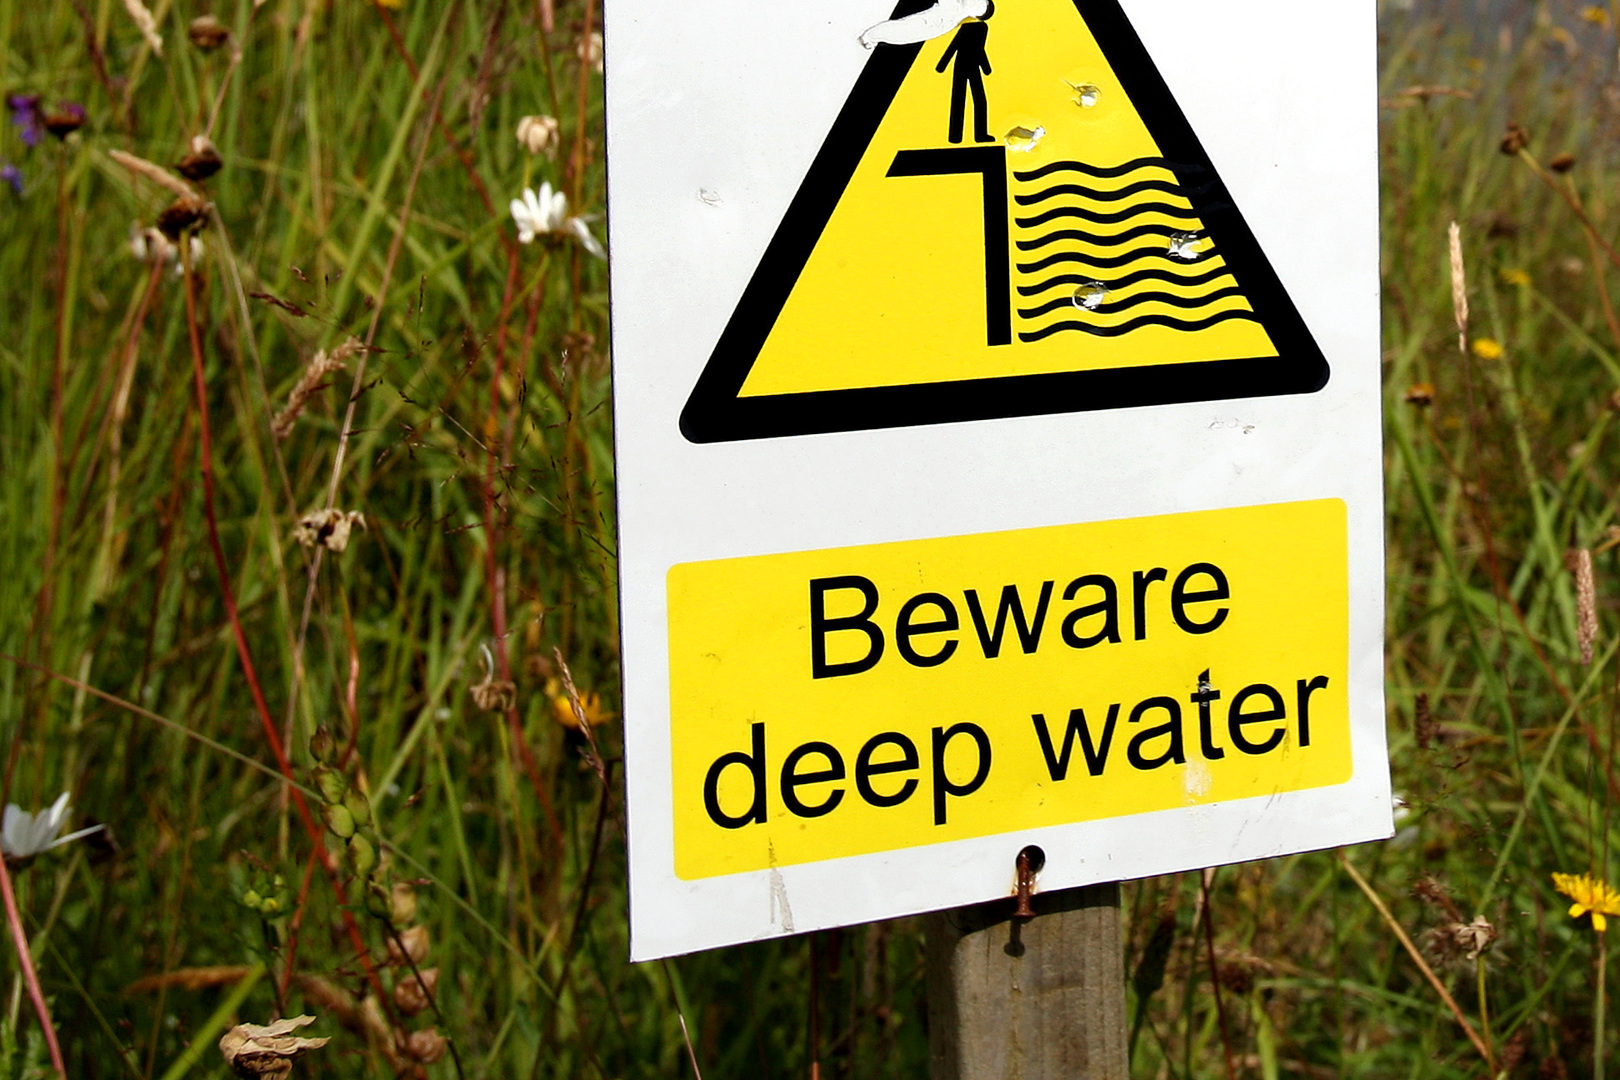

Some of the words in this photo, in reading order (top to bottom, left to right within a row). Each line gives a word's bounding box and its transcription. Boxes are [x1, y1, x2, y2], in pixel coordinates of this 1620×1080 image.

[809, 562, 1230, 680] Beware
[703, 722, 992, 830] deep
[1031, 668, 1330, 782] water
